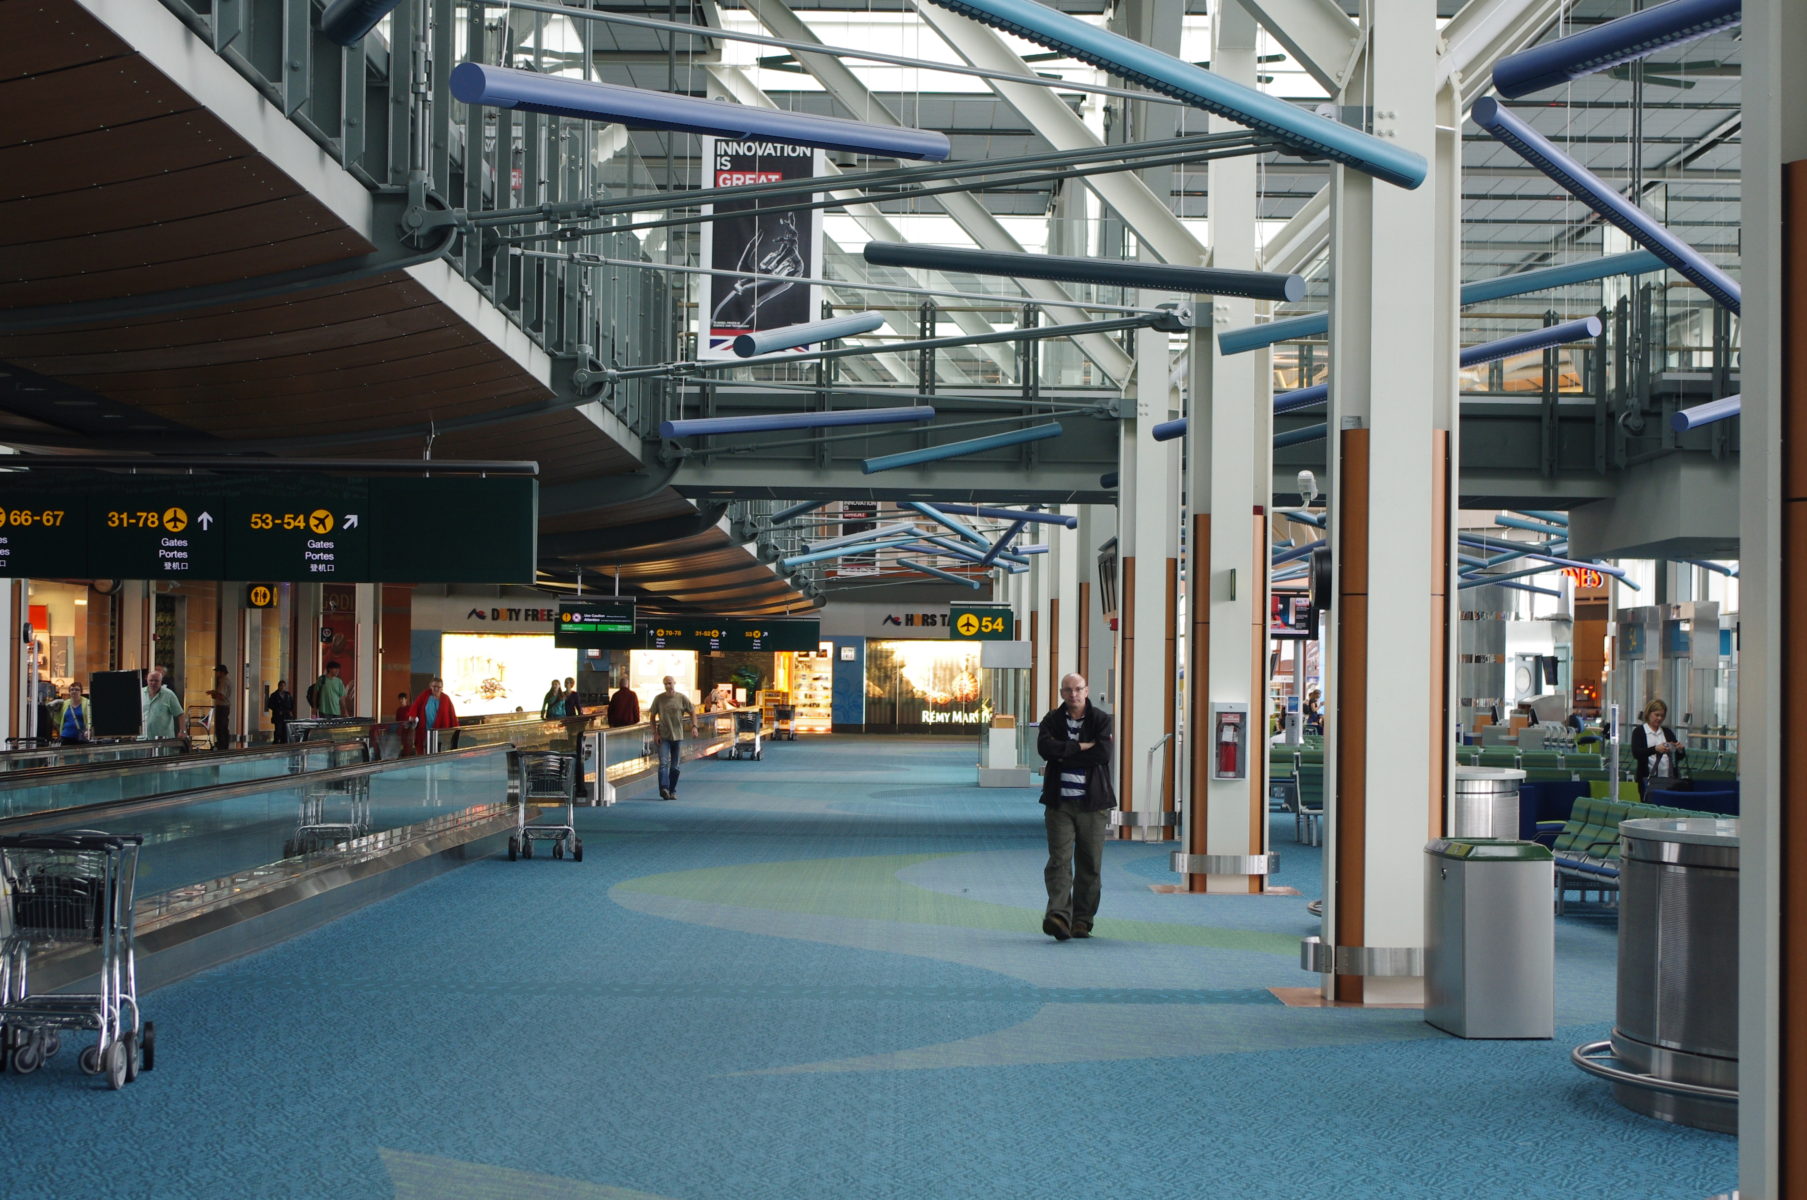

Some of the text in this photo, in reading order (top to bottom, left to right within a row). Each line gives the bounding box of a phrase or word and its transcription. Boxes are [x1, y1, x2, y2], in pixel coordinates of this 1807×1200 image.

[716, 141, 811, 156] INNOVATION
[716, 156, 731, 170] IS
[719, 173, 780, 188] GREAT
[9, 510, 65, 526] 66-67
[107, 511, 159, 528] 31-78
[250, 513, 306, 530] 53-54
[161, 537, 188, 547] Gates
[307, 539, 334, 549] Gates
[159, 549, 188, 559] Portes
[305, 551, 334, 561] Portes
[164, 562, 188, 570] 登机口
[309, 564, 335, 572] 登机口
[491, 608, 554, 622] DUTY FREE
[905, 613, 937, 627] HORS
[981, 616, 1004, 633] 54
